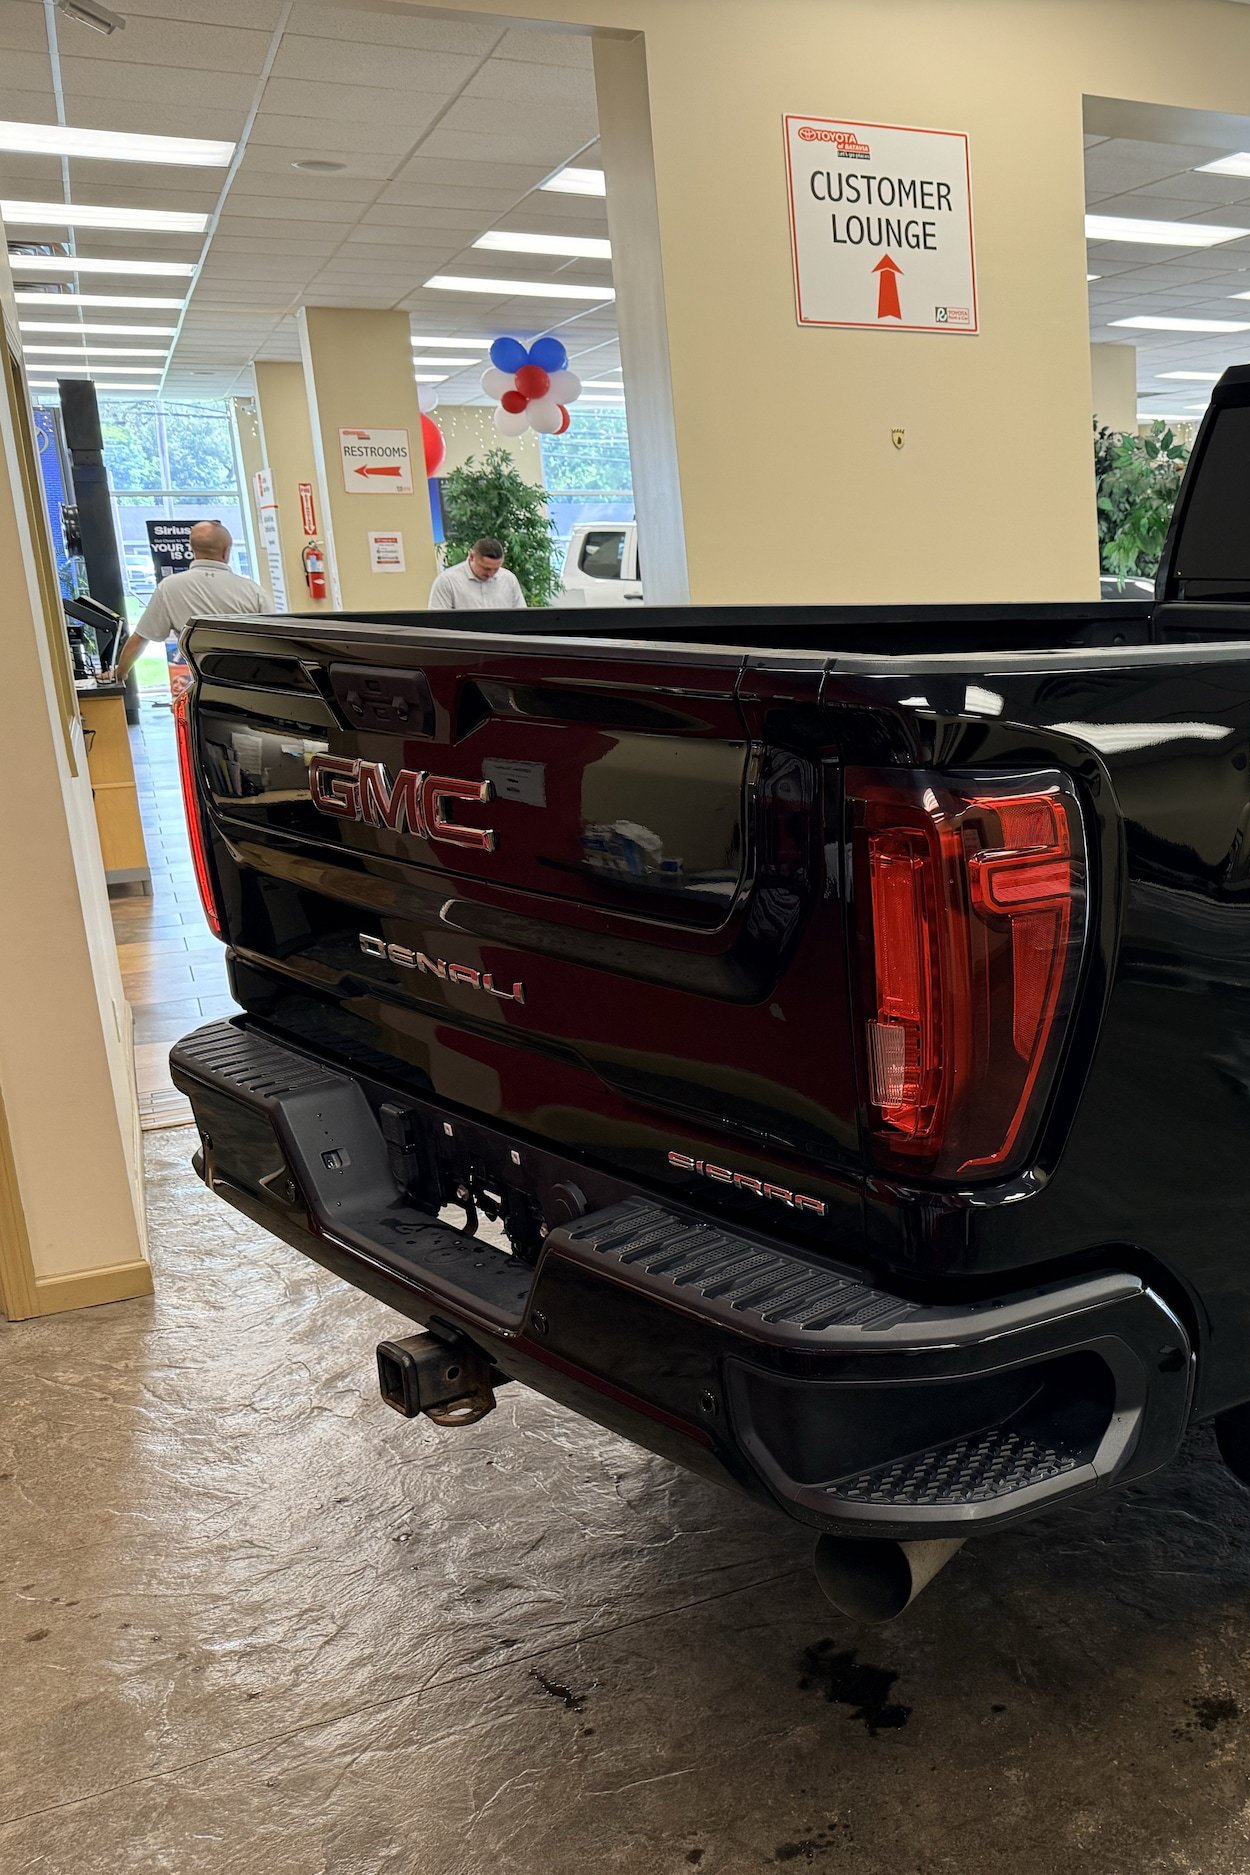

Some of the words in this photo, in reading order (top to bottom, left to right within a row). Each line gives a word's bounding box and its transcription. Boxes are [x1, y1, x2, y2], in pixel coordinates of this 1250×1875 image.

[816, 131, 857, 144] TOYOTA
[810, 170, 953, 212] CUSTOMER
[831, 213, 938, 251] LOUNGE
[343, 446, 408, 458] RESTROOMS
[151, 544, 184, 552] YOUR
[171, 551, 183, 560] IS
[309, 752, 498, 853] GMC
[359, 932, 526, 1005] DENALI
[667, 1151, 827, 1217] SIERRA
